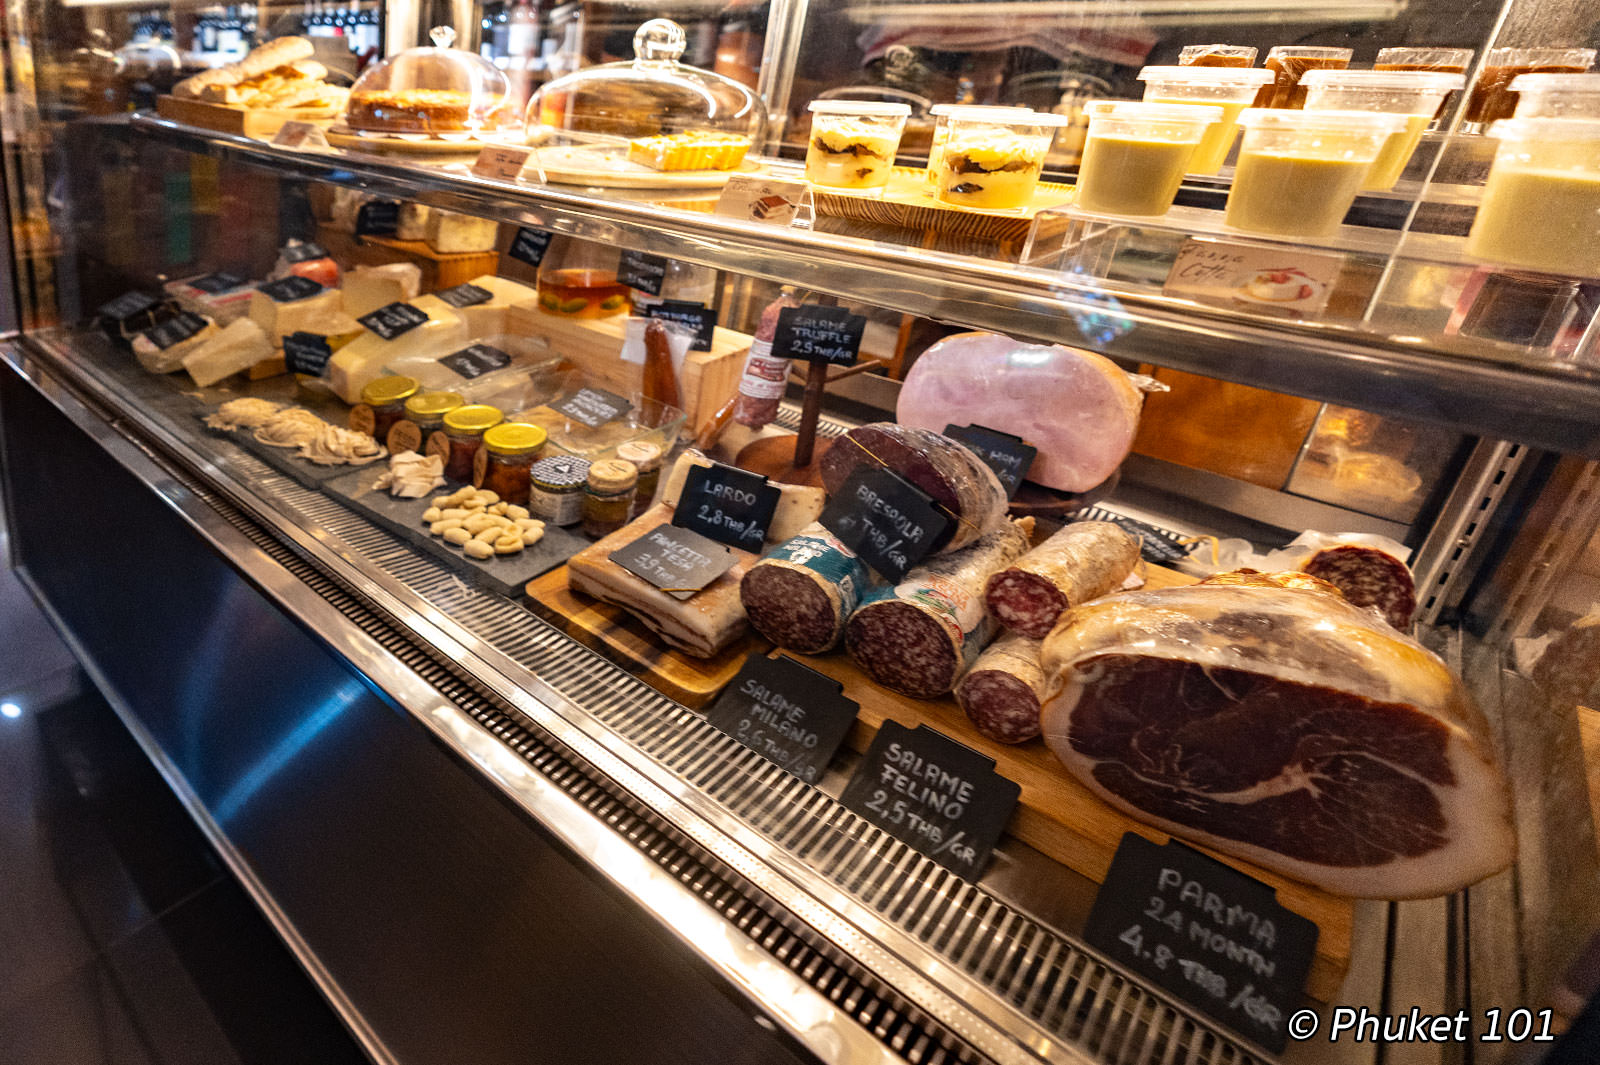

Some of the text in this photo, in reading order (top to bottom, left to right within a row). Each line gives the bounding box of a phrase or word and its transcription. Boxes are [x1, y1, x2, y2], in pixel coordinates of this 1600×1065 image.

[790, 327, 853, 345] TRUFFLE
[791, 316, 848, 332] SALAME
[704, 480, 757, 506] LARDO
[649, 532, 713, 568] PANCETTA
[661, 548, 694, 572] TESA
[740, 679, 807, 724] SALAME
[751, 703, 818, 749] MILANO
[881, 763, 963, 820] FELINO
[884, 743, 975, 804] SALAME
[1158, 868, 1276, 949] PARMA
[1189, 920, 1276, 978] MONTH
